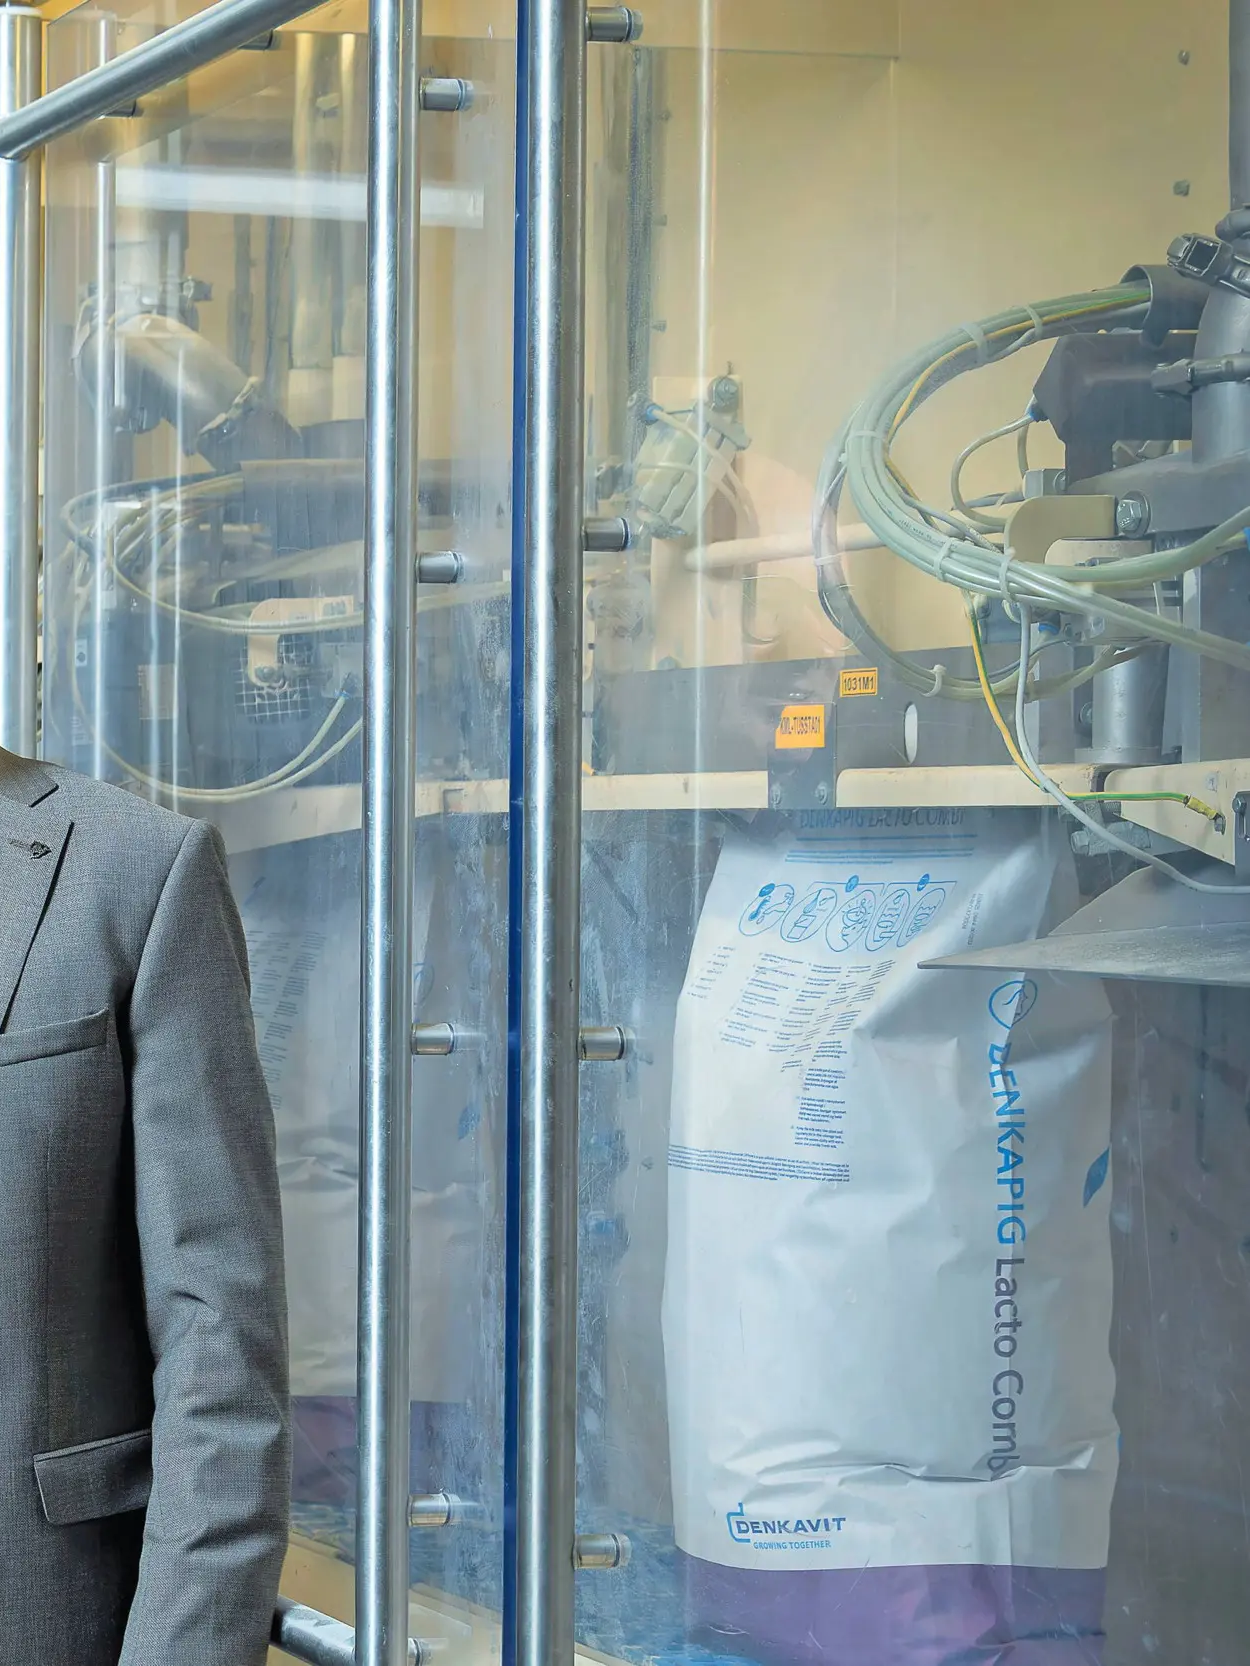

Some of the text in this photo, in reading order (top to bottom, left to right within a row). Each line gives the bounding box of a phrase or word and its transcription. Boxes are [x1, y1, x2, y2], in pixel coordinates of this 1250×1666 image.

[987, 1042, 1026, 1481] DENKAPIG Lacto Comb
[735, 1517, 847, 1534] DENKAVIT
[753, 1540, 831, 1550] GROWING TOGETHER
